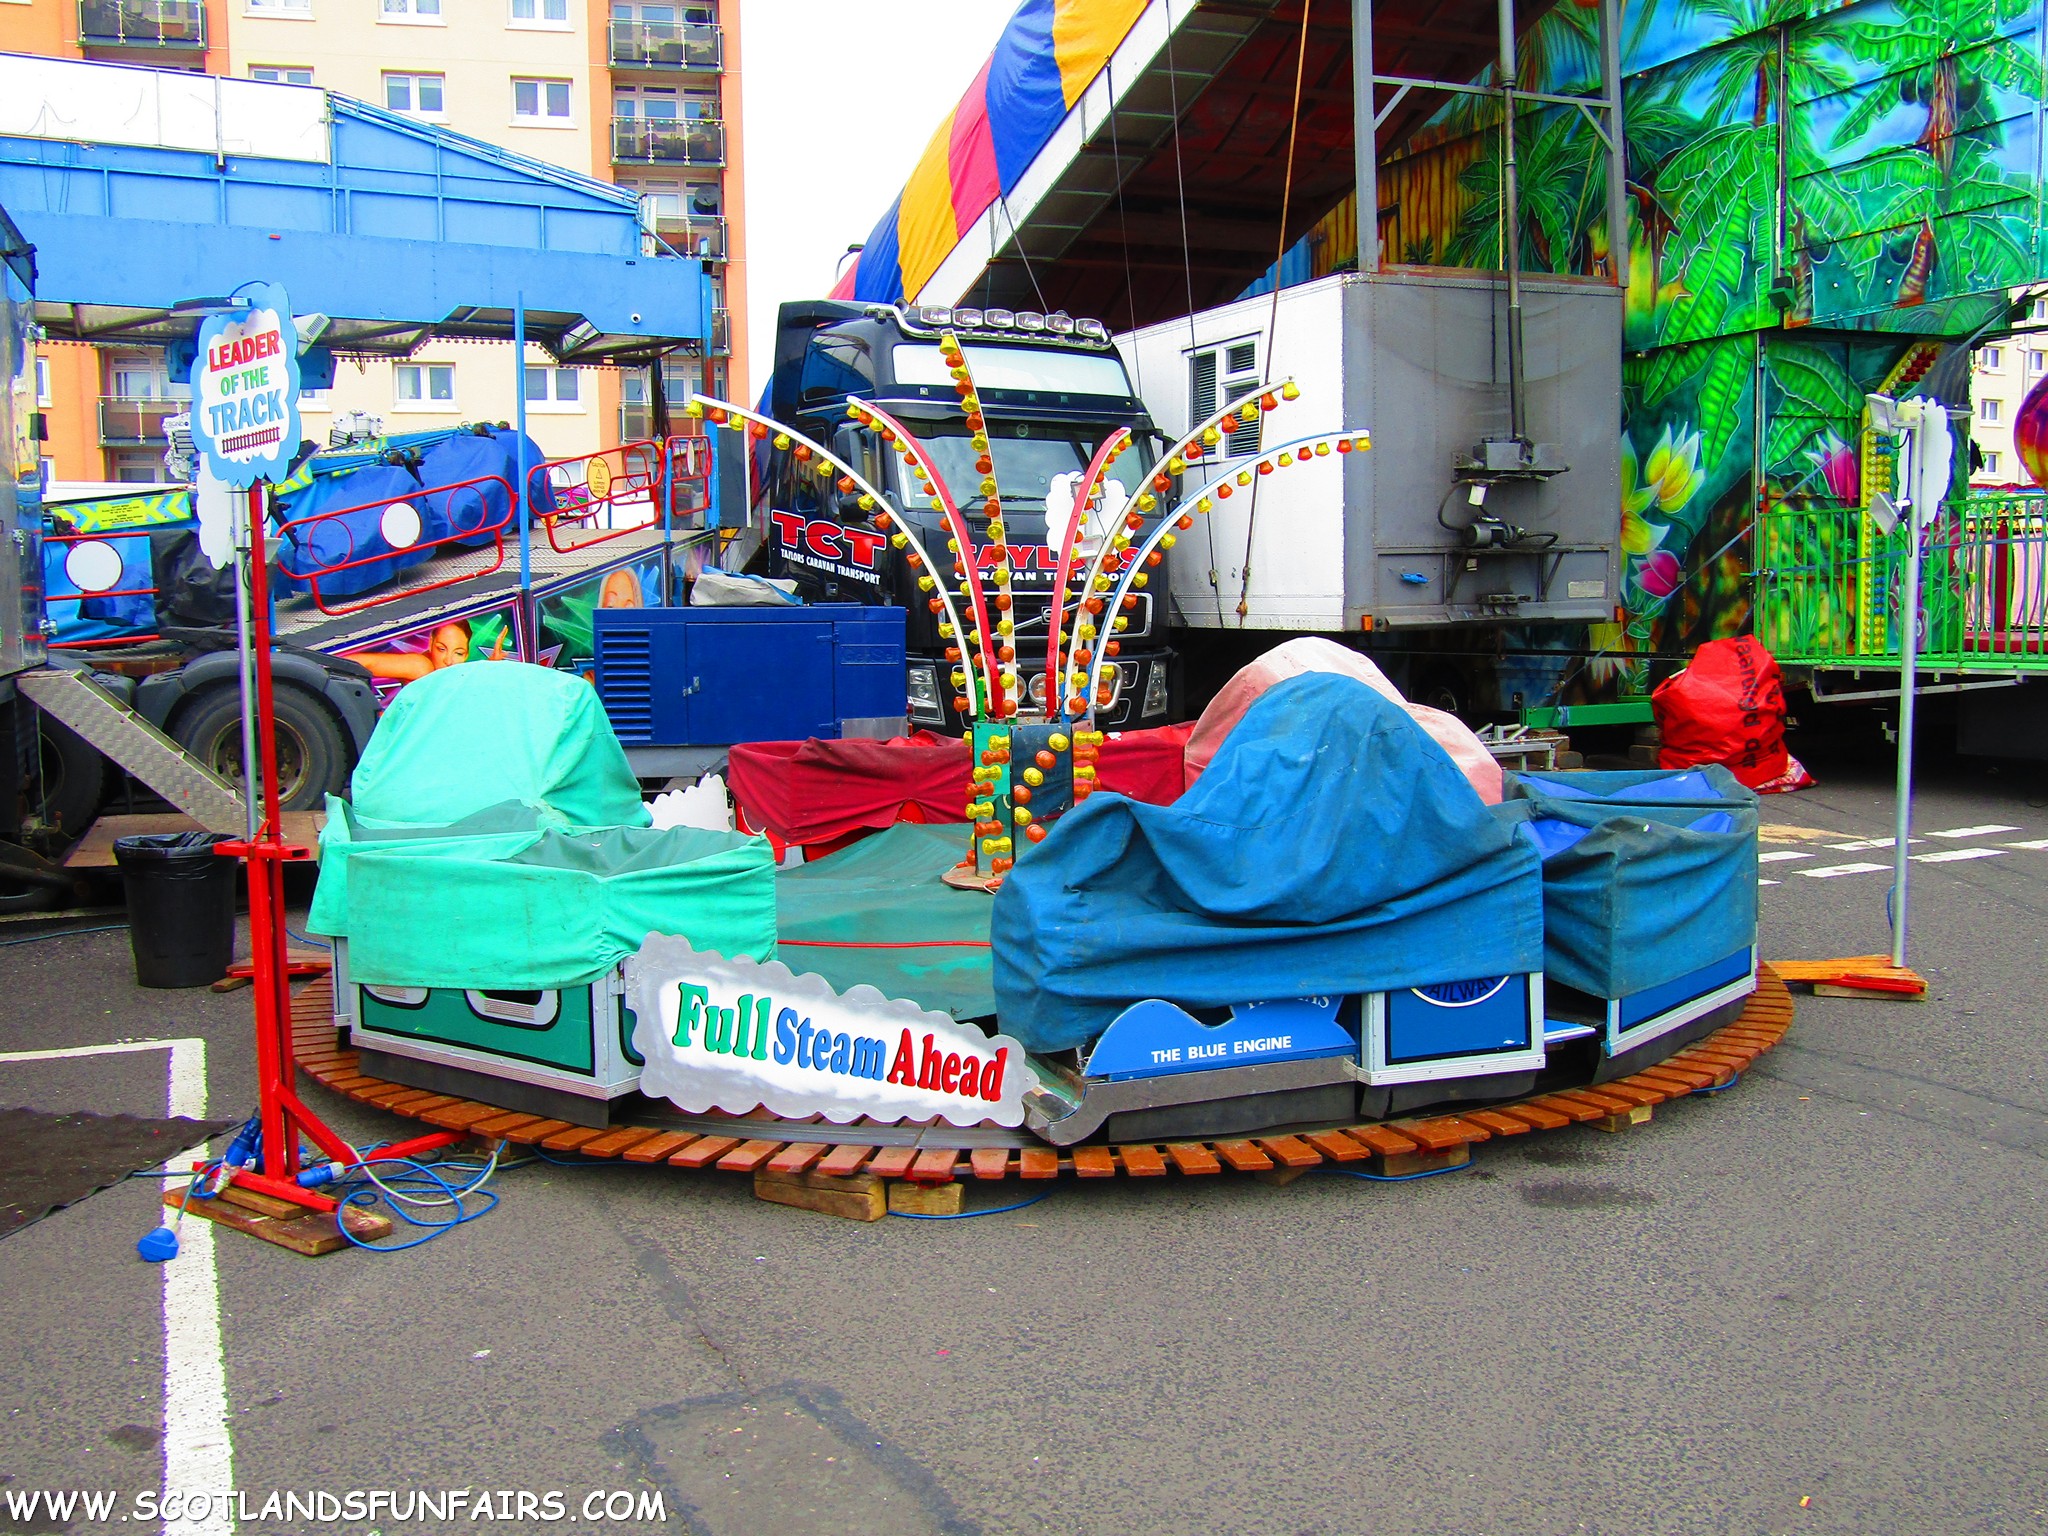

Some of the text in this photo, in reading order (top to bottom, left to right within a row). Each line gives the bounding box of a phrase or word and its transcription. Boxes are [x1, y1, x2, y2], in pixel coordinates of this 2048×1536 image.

[208, 329, 281, 373] LEADER
[220, 366, 270, 397] OF THE
[208, 388, 285, 436] TRACK
[771, 509, 887, 570] TCT
[948, 544, 1142, 571] AYLS
[780, 548, 881, 585] TAYLORS CARAVAN TRANSPORT
[671, 981, 1009, 1102] Full Steam Ahead
[1151, 1035, 1292, 1064] THE BLUE ENGINE
